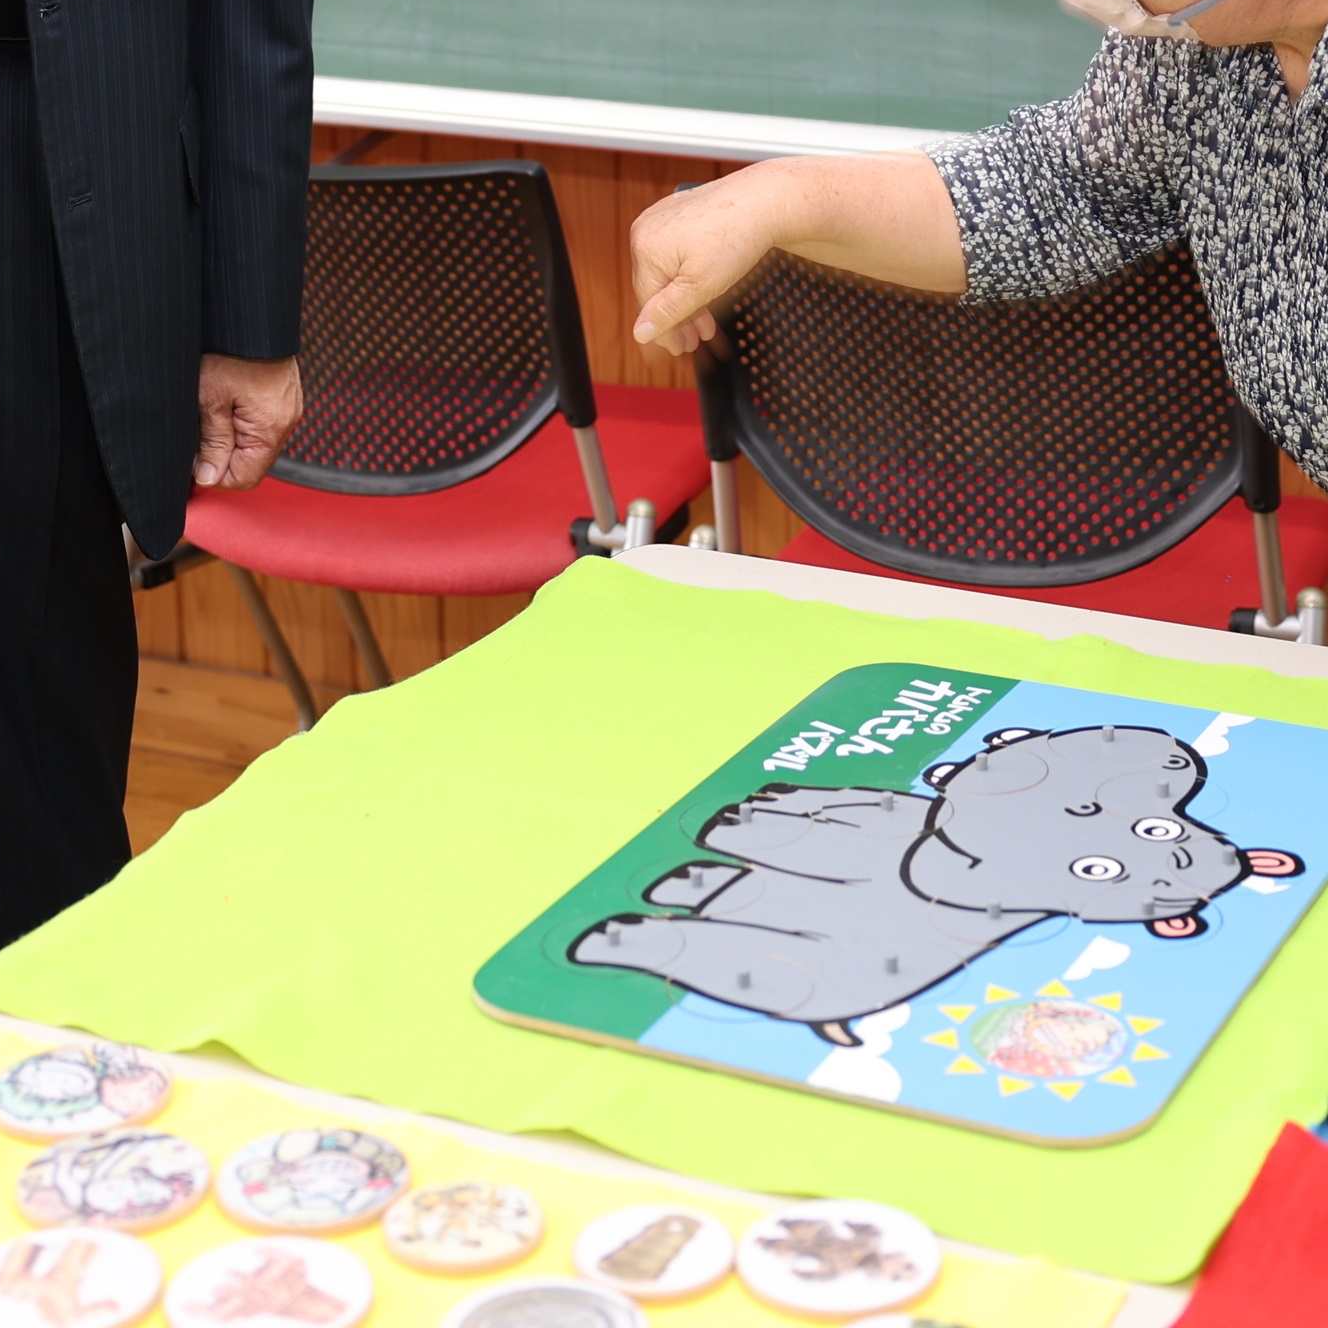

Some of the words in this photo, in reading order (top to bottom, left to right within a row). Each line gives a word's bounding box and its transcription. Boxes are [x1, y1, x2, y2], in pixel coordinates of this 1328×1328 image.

[835, 679, 957, 757] カバさん
[922, 685, 993, 736] トムトムの
[762, 720, 846, 772] パズル
